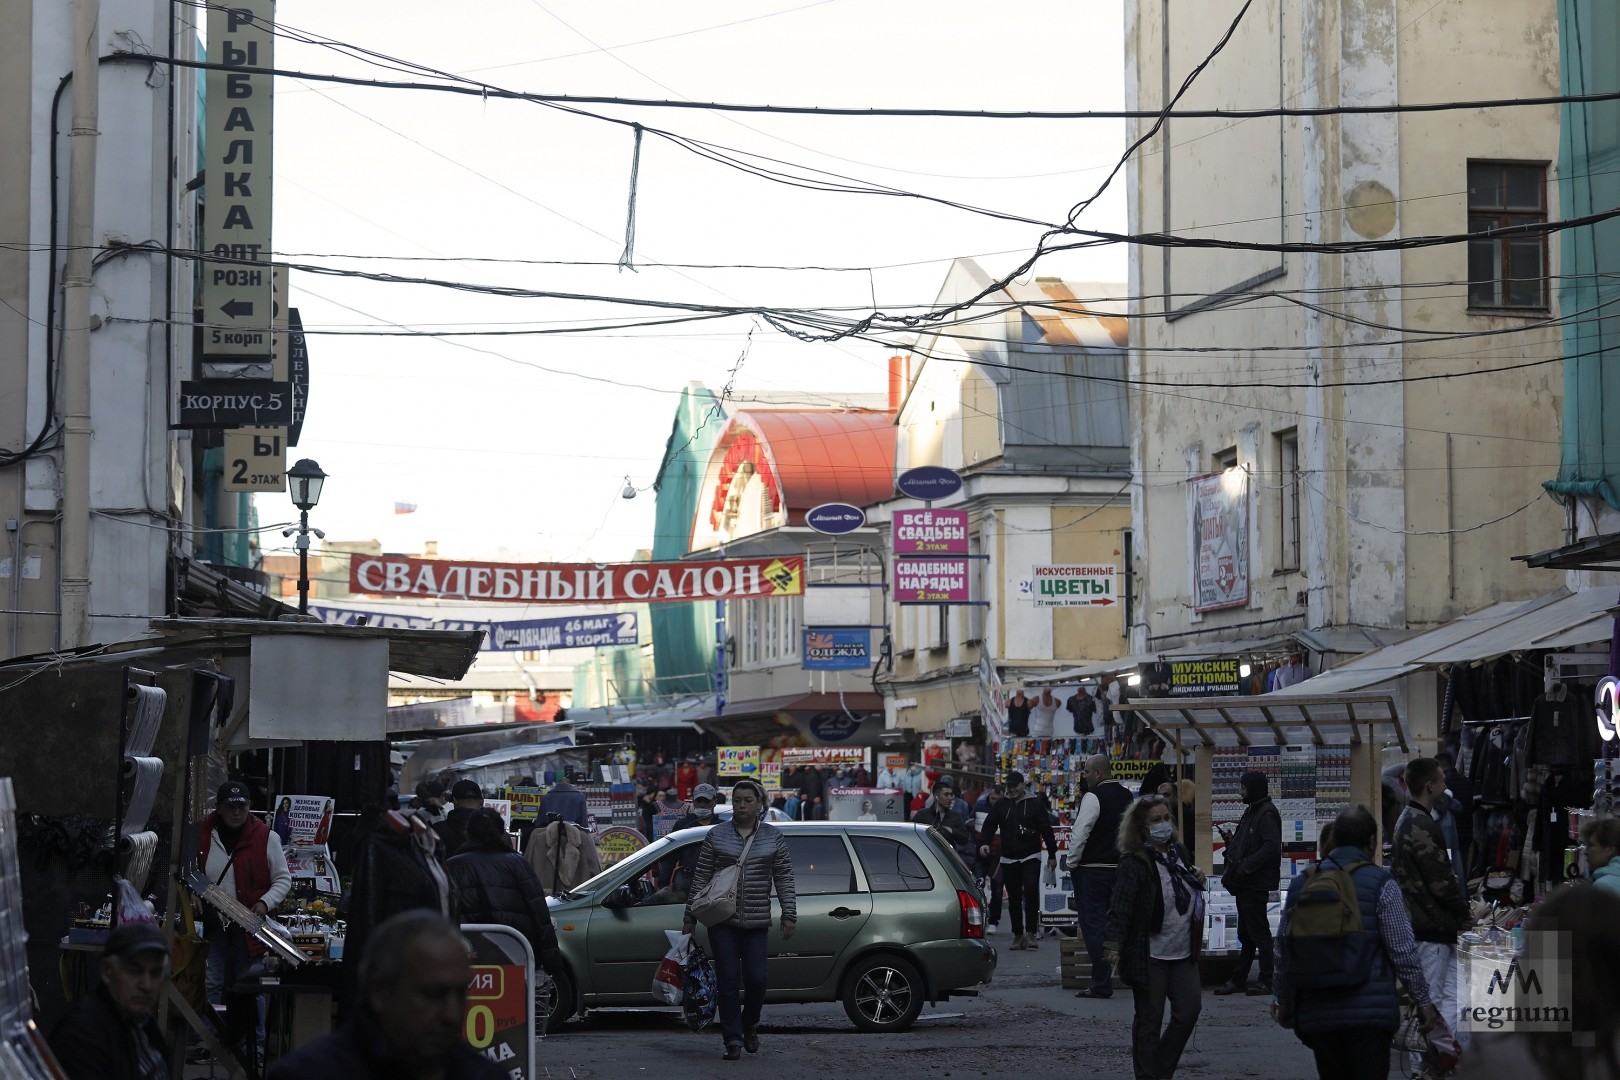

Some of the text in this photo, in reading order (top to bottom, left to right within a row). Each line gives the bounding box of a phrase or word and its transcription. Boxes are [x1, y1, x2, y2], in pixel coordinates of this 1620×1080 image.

[222, 8, 257, 229] РЫБАЛКА
[214, 244, 262, 261] ОПТ
[213, 270, 262, 286] РОЗН
[212, 330, 262, 347] 5 корп
[293, 335, 304, 421] ЭЛЕГАНТ
[266, 391, 285, 411] 5
[231, 459, 280, 485] 2 ЭТАЖ
[903, 512, 960, 527] ВСЁ для
[898, 527, 965, 542] СВАДЬБЫ
[916, 541, 924, 551] 2
[897, 562, 965, 576] СВАДЕБНЫЕ
[1035, 566, 1114, 576] ИСКУССТВЕННЫЕ
[357, 560, 761, 600] СВАДЕБНЫЙ САЛОН
[899, 577, 963, 592] НАРЯДЫ
[917, 590, 925, 600] 2
[1040, 579, 1110, 598] ЦВЕТЫ
[565, 618, 613, 633] 46 МАГ.
[616, 613, 637, 637] 2
[495, 625, 561, 649] ФИНЛЯНДИЯ
[565, 633, 614, 646] 8 КОРП.
[810, 632, 817, 640] 2
[810, 648, 866, 658] ОДЕЖДА
[1171, 660, 1237, 674] МУЖСКИЕ
[1172, 672, 1238, 685] КОСТЮМЫ
[1173, 683, 1239, 694] ПИДЖАКИ РУБАШКИ
[814, 748, 862, 758] КУРТКИ
[720, 761, 727, 771] 2
[886, 798, 895, 810] 2
[289, 812, 323, 820] КОСТЮМЫ
[290, 820, 320, 829] ПЛАТЬЯ
